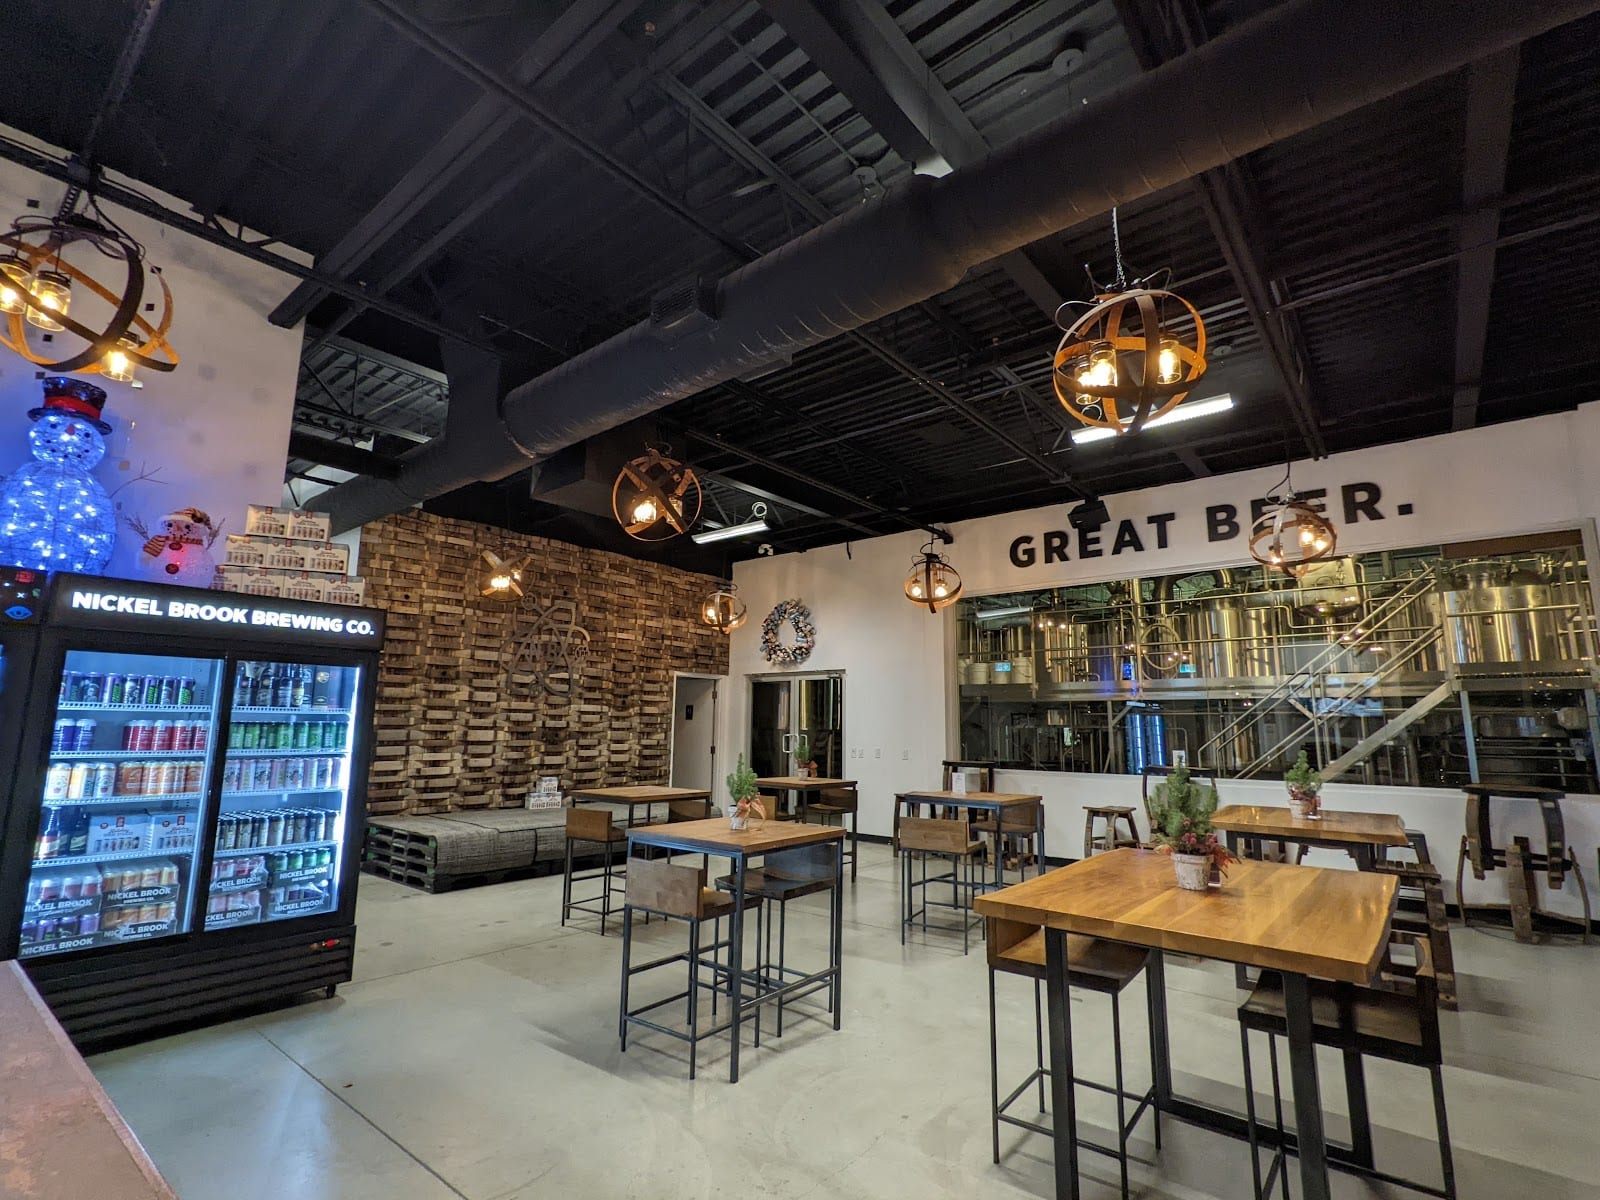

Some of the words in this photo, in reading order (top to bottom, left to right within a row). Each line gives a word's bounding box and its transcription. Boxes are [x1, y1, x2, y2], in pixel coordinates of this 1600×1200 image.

[1009, 511, 1176, 569] GREAT
[72, 591, 163, 617] NICKEL
[167, 601, 249, 625] BROOK
[251, 610, 344, 634] BREWING
[345, 620, 376, 637] CO.
[210, 880, 236, 891] ICKEL
[107, 890, 139, 901] NICKEL
[140, 887, 172, 897] BROOK
[205, 913, 225, 922] CKEL
[137, 923, 169, 934] BROOK
[21, 943, 58, 956] NICKEL
[59, 937, 95, 949] BROOK
